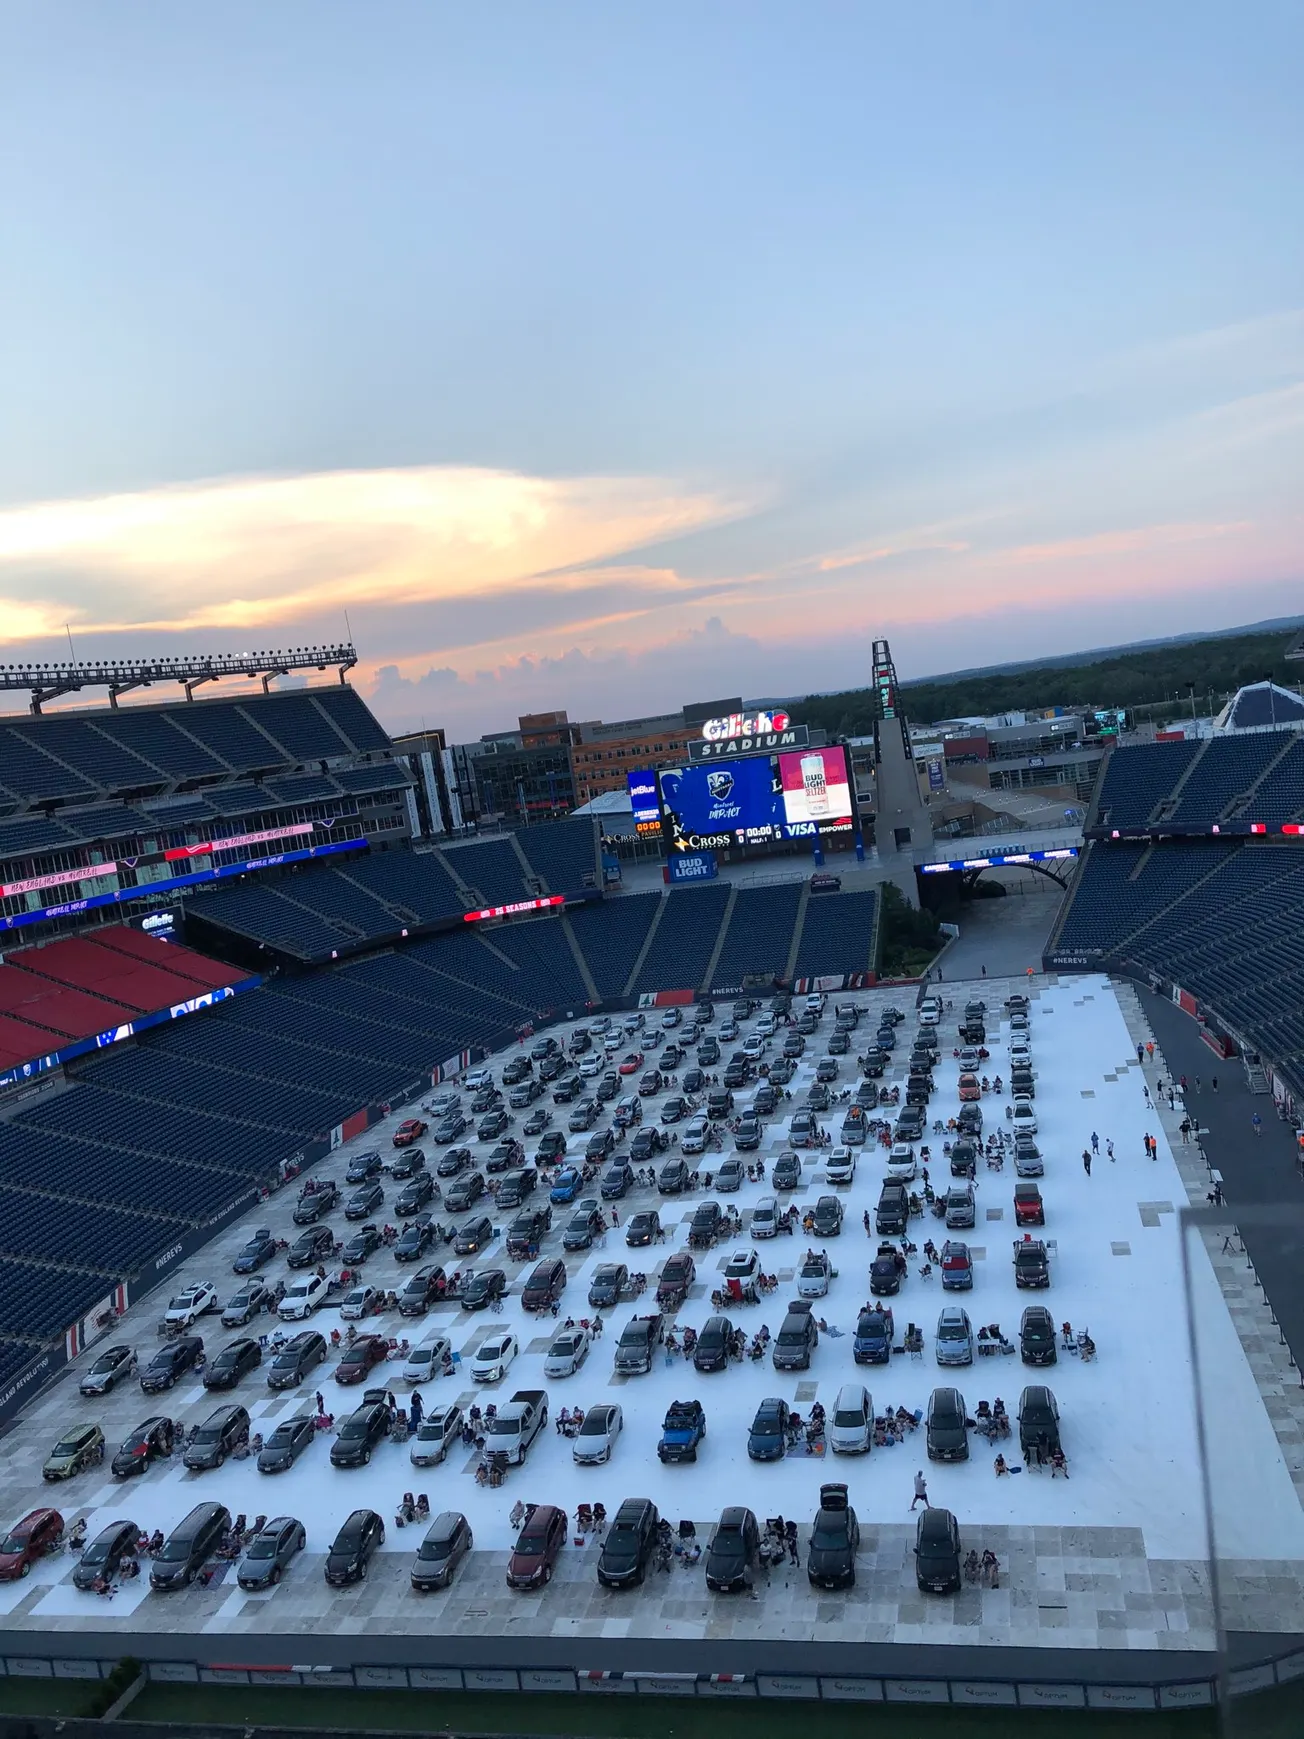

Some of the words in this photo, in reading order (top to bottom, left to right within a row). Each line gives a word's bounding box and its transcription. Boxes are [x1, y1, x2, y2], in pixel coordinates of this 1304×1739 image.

[702, 732, 796, 756] STADIUM
[804, 780, 826, 788] LIGHT
[631, 786, 655, 797] jetBlue
[805, 787, 826, 796] SELTZER
[708, 806, 741, 819] IMPACT
[747, 826, 772, 837] 00:00
[784, 822, 816, 836] VISA
[819, 824, 852, 833] EMPOWER
[678, 858, 702, 868] BUD
[676, 866, 707, 877] LIGHT
[11, 884, 24, 892] NEW
[26, 878, 55, 890] ENGLAND
[506, 901, 536, 913] SEASONS
[142, 913, 174, 929] Gillette
[712, 986, 744, 995] #NEREVS
[155, 1243, 182, 1269] #NEREVS
